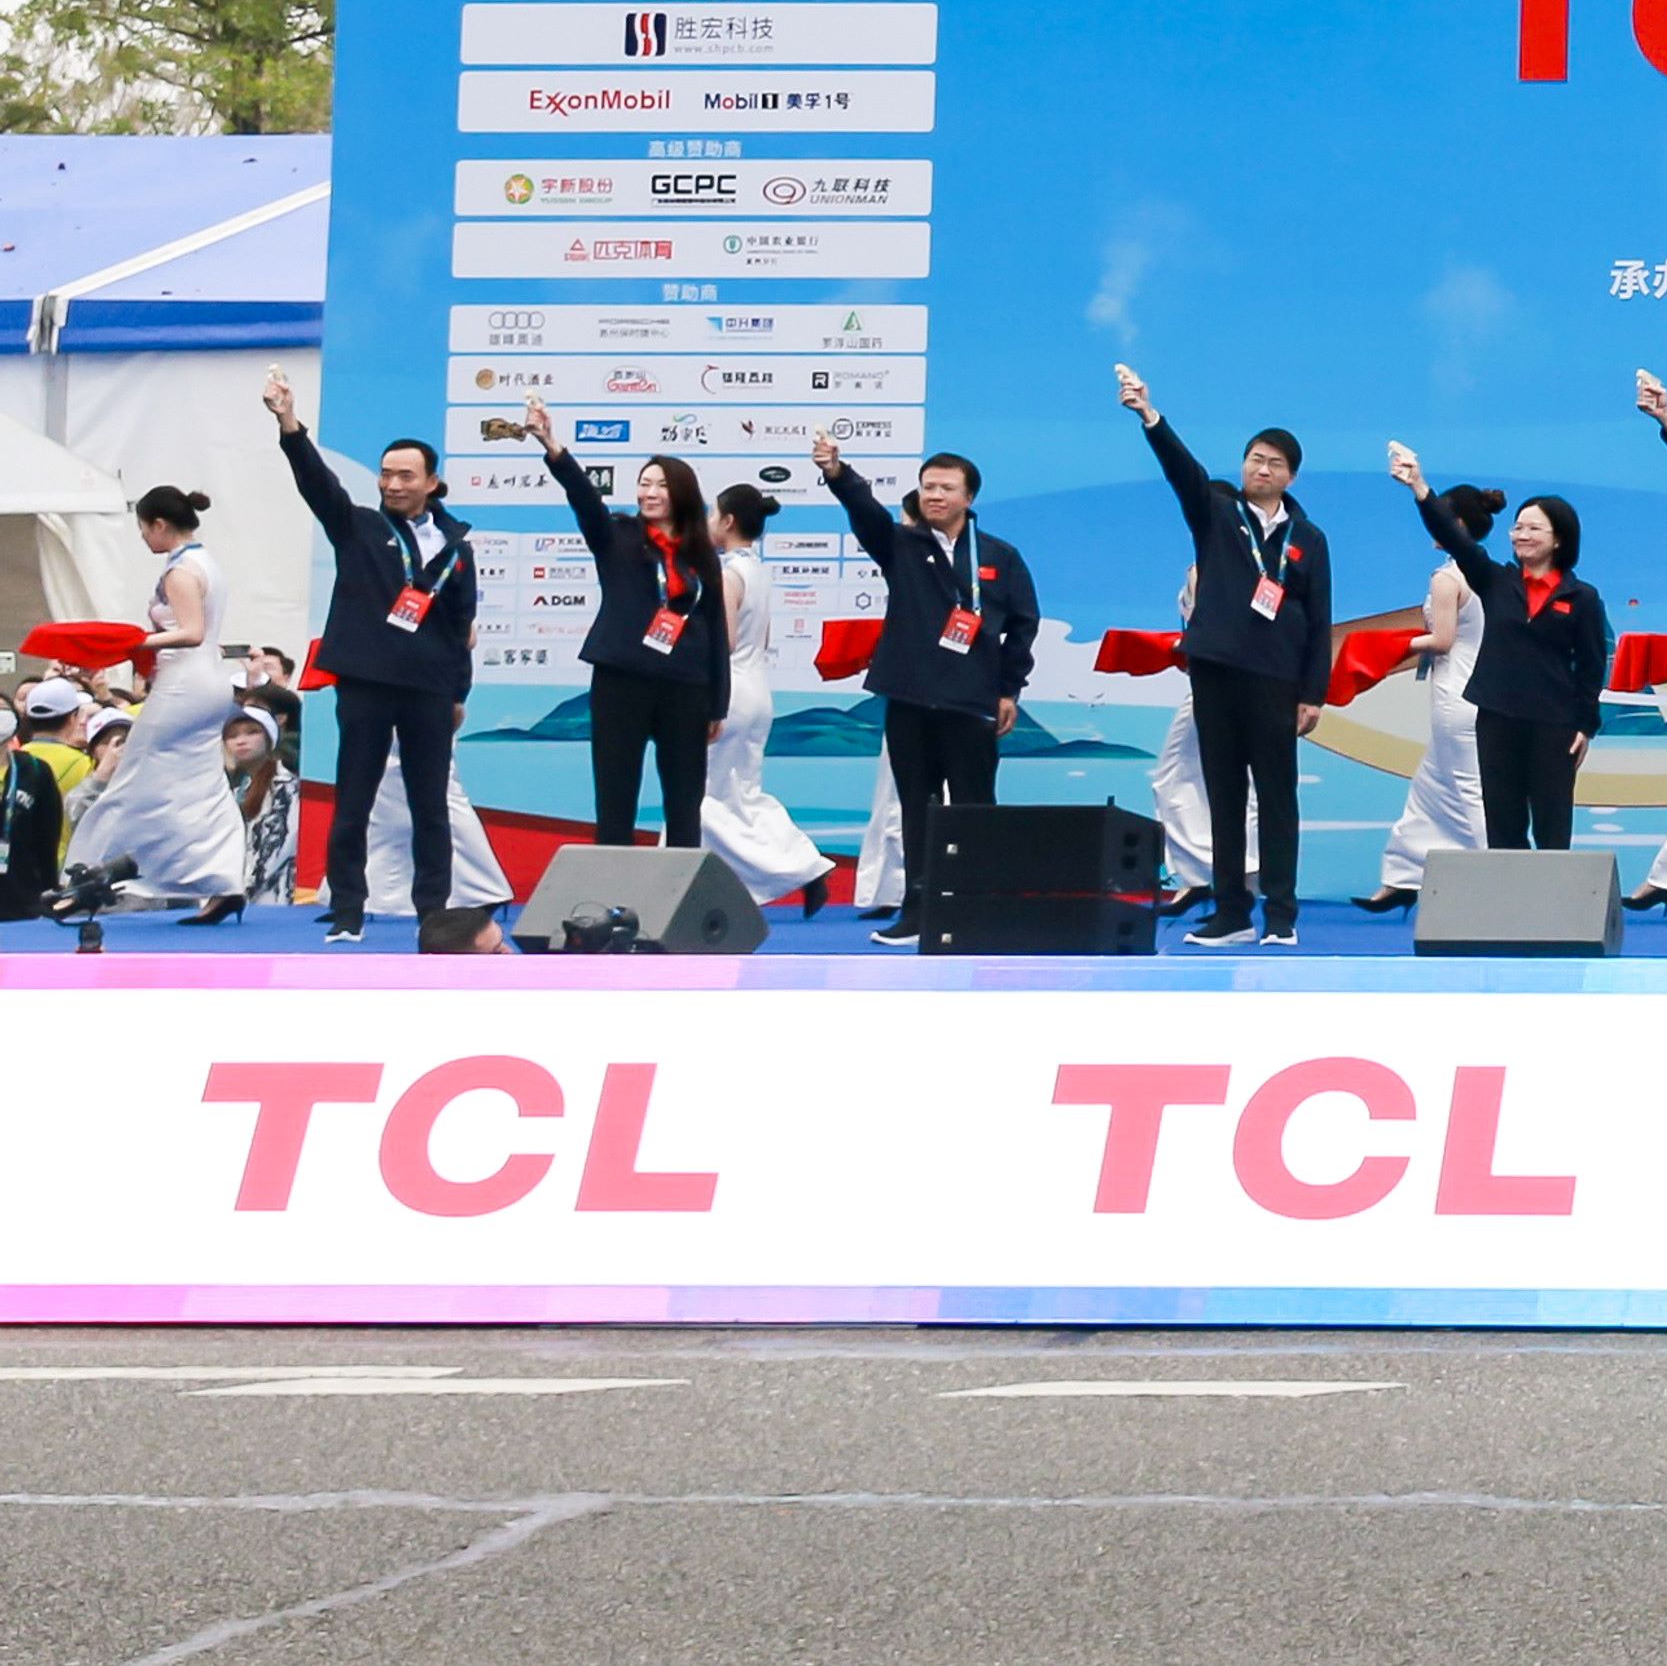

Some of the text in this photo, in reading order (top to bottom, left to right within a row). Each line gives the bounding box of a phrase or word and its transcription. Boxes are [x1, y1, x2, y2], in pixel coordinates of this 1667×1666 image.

[674, 17, 774, 40] 胜宏科技
[529, 89, 671, 116] ExxonMobil
[704, 93, 758, 110] Mobil
[648, 140, 742, 158] 高级赞助商
[651, 174, 737, 194] GCPC
[812, 178, 891, 193] 九联科技
[809, 194, 889, 205] UNIONMAN
[662, 284, 718, 301] 赞助商
[551, 595, 586, 606] DGM
[200, 1054, 720, 1218] TCL
[1051, 1056, 1578, 1221] TCL
